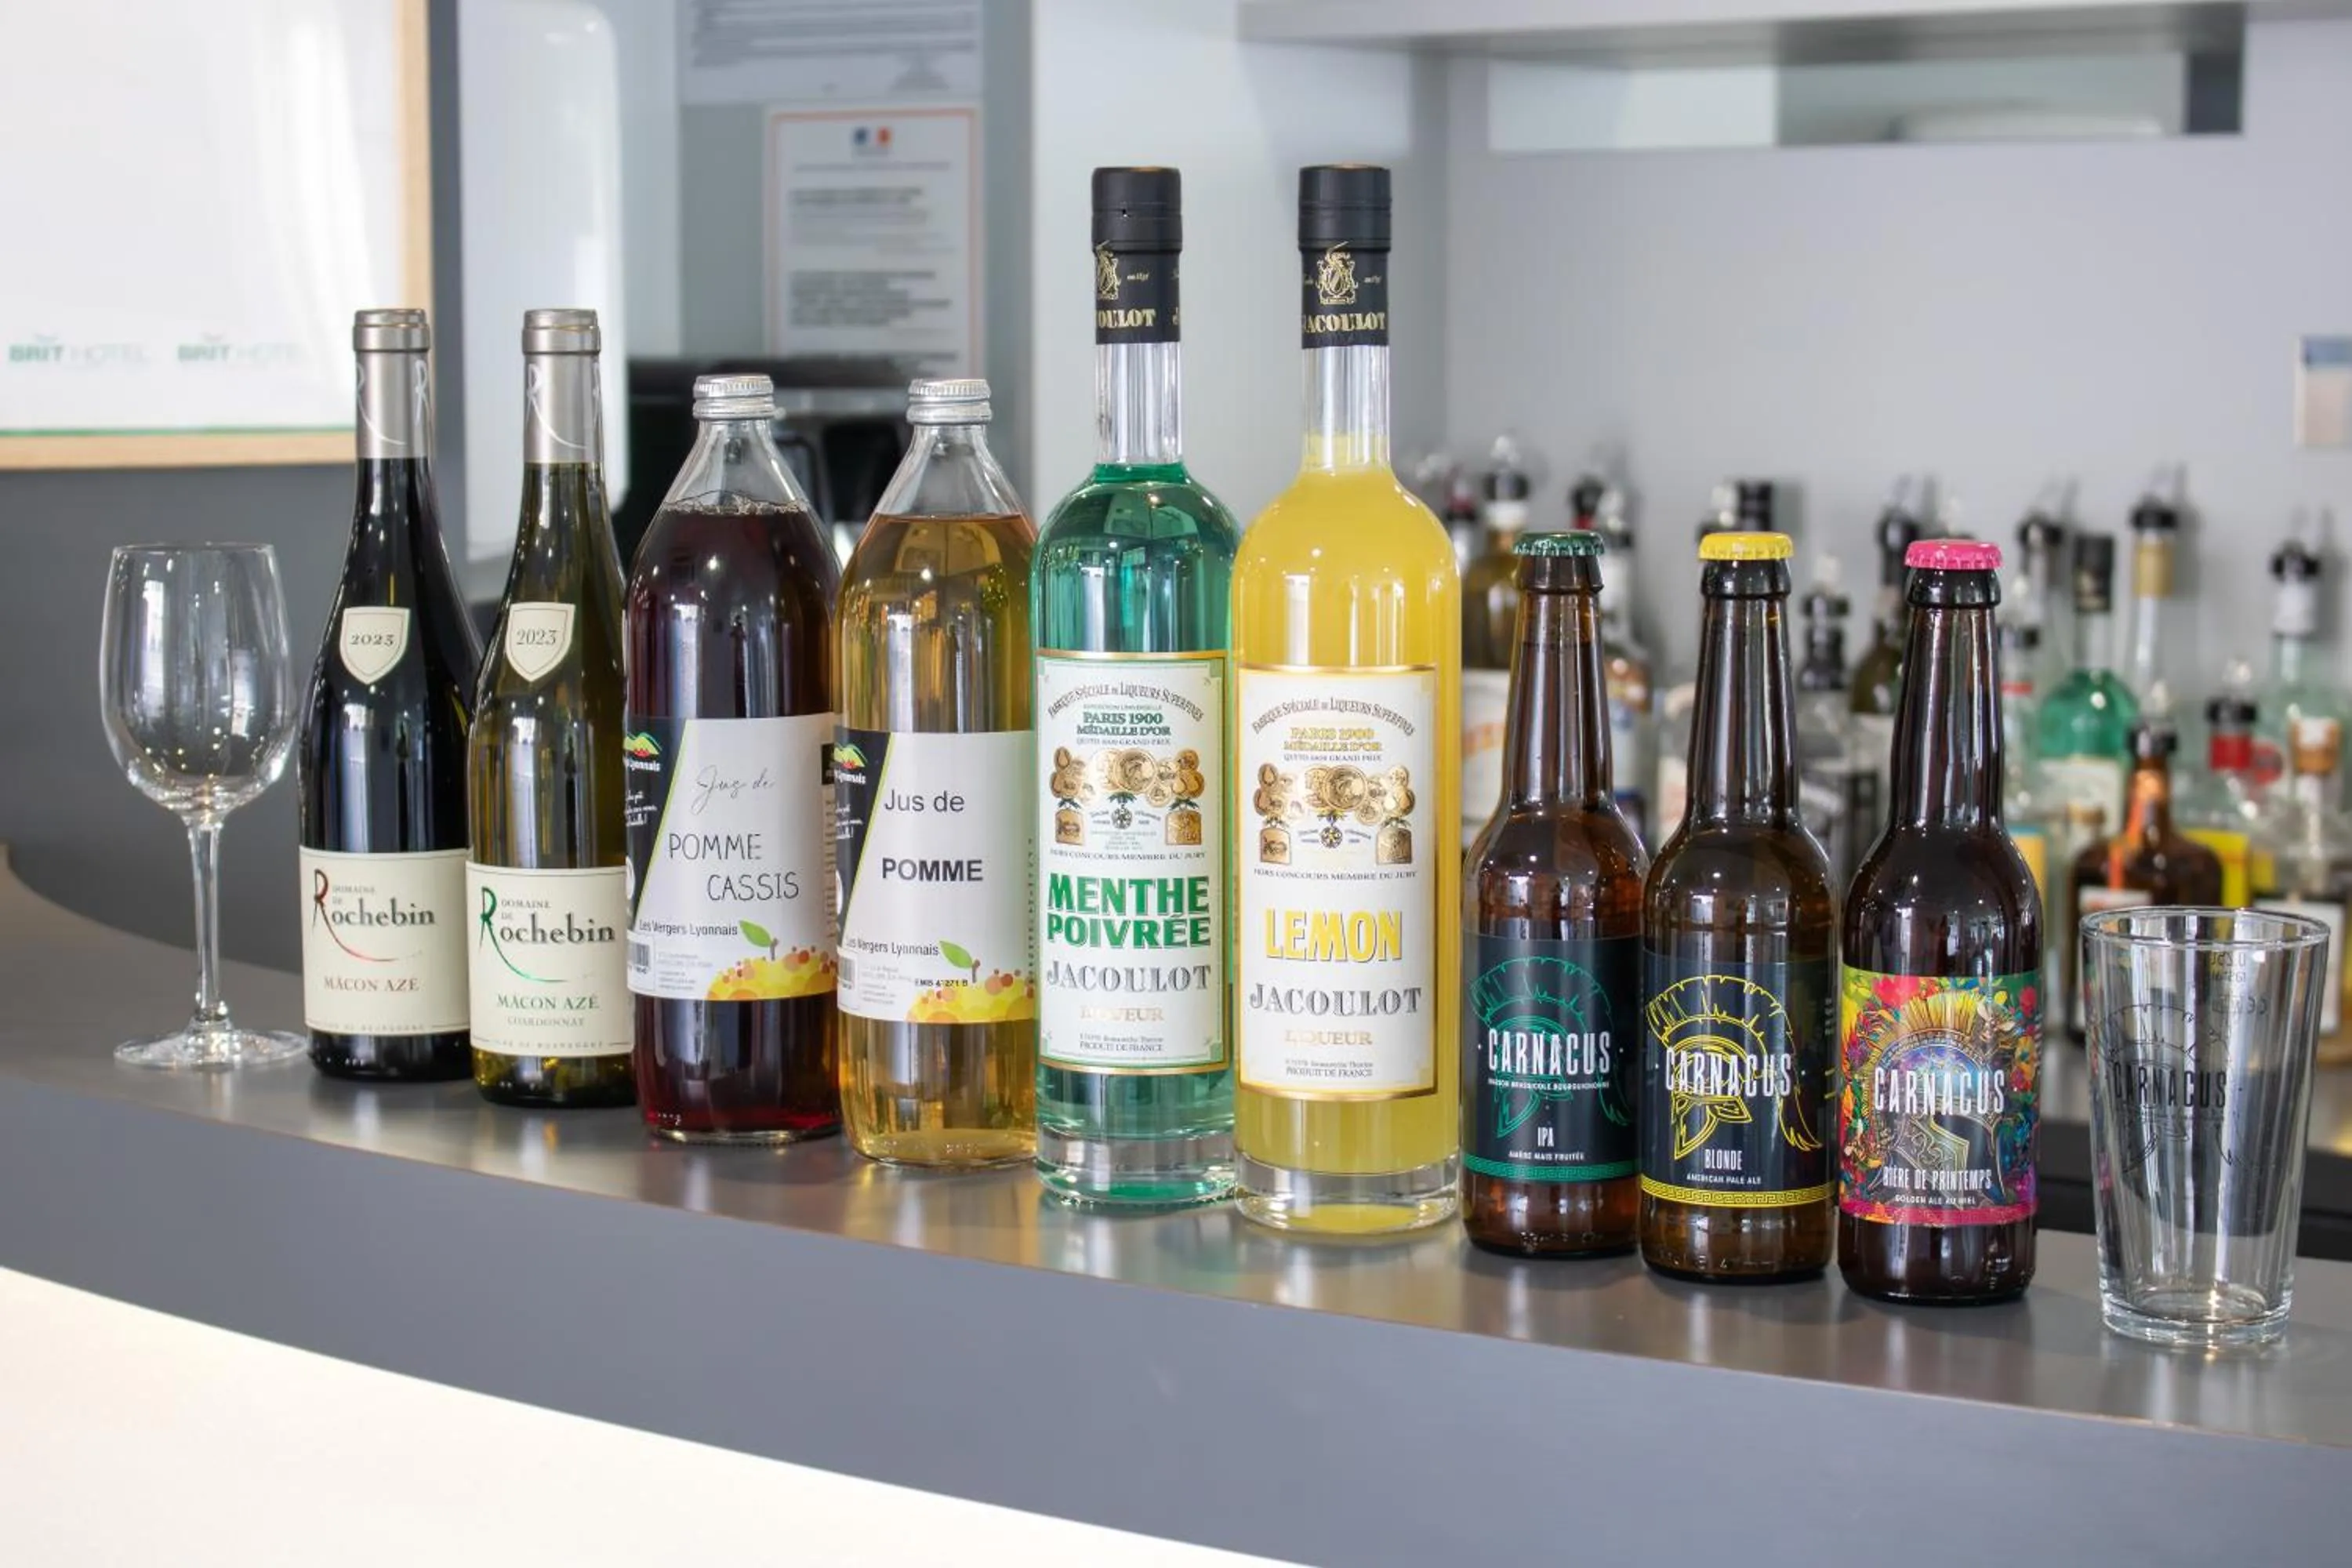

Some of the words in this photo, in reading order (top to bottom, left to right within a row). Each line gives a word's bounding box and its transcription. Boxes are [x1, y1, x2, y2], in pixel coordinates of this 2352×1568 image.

[9, 344, 64, 363] BRIT
[177, 343, 230, 362] BRIT
[350, 633, 394, 646] 2023
[516, 628, 559, 646] 2023
[1083, 711, 1126, 724] PARIS
[1128, 712, 1163, 724] 1900
[1076, 724, 1138, 736] MÉDAILLE
[1290, 727, 1337, 741] PARIS
[752, 768, 776, 791] de
[884, 789, 924, 812] Jus
[933, 790, 965, 812] de
[669, 833, 762, 861] POMME
[882, 858, 984, 883] POMME
[1276, 870, 1329, 880] CONCOURS
[1331, 872, 1377, 880] MEMBRE
[1379, 871, 1393, 880] DU
[1395, 869, 1418, 879] JURY
[707, 871, 800, 902] CASSIS
[1047, 872, 1210, 916] MENTHE
[312, 868, 436, 961] Rochebin
[501, 898, 552, 909] DOMAINE
[479, 887, 616, 982] Rochebin
[639, 919, 652, 932] Les
[652, 920, 688, 936] Vergers
[690, 924, 739, 937] Lyonnais
[1047, 913, 1211, 949] POIVRÉE
[1265, 908, 1403, 964] LEMON
[891, 942, 939, 958] Lyonnais
[1047, 960, 1212, 993] JACOULOT
[497, 992, 556, 1011] MÂCON
[563, 991, 600, 1011] AZÉ
[1249, 982, 1422, 1017] JACOULOT
[1284, 1029, 1374, 1046] LQUEUR
[1488, 1028, 1611, 1076] CARNACUS
[1338, 1068, 1374, 1078] FRANCE
[1665, 1047, 1792, 1098] CARNACUS
[1873, 1067, 2005, 1116] CARNACUS
[2113, 1061, 2227, 1109] CARNACUS
[1537, 1126, 1555, 1148] IPA
[1704, 1149, 1744, 1171] BLONDE
[1686, 1173, 1724, 1183] AMERICAN
[1726, 1175, 1745, 1185] PALE
[1747, 1176, 1762, 1185] ALE
[1882, 1164, 1910, 1189] BIÈRE
[1914, 1168, 1927, 1190] DE
[1932, 1168, 1992, 1191] PRINTEMPS
[1894, 1194, 1927, 1204] GOLDEN
[1929, 1196, 1943, 1205] ALE
